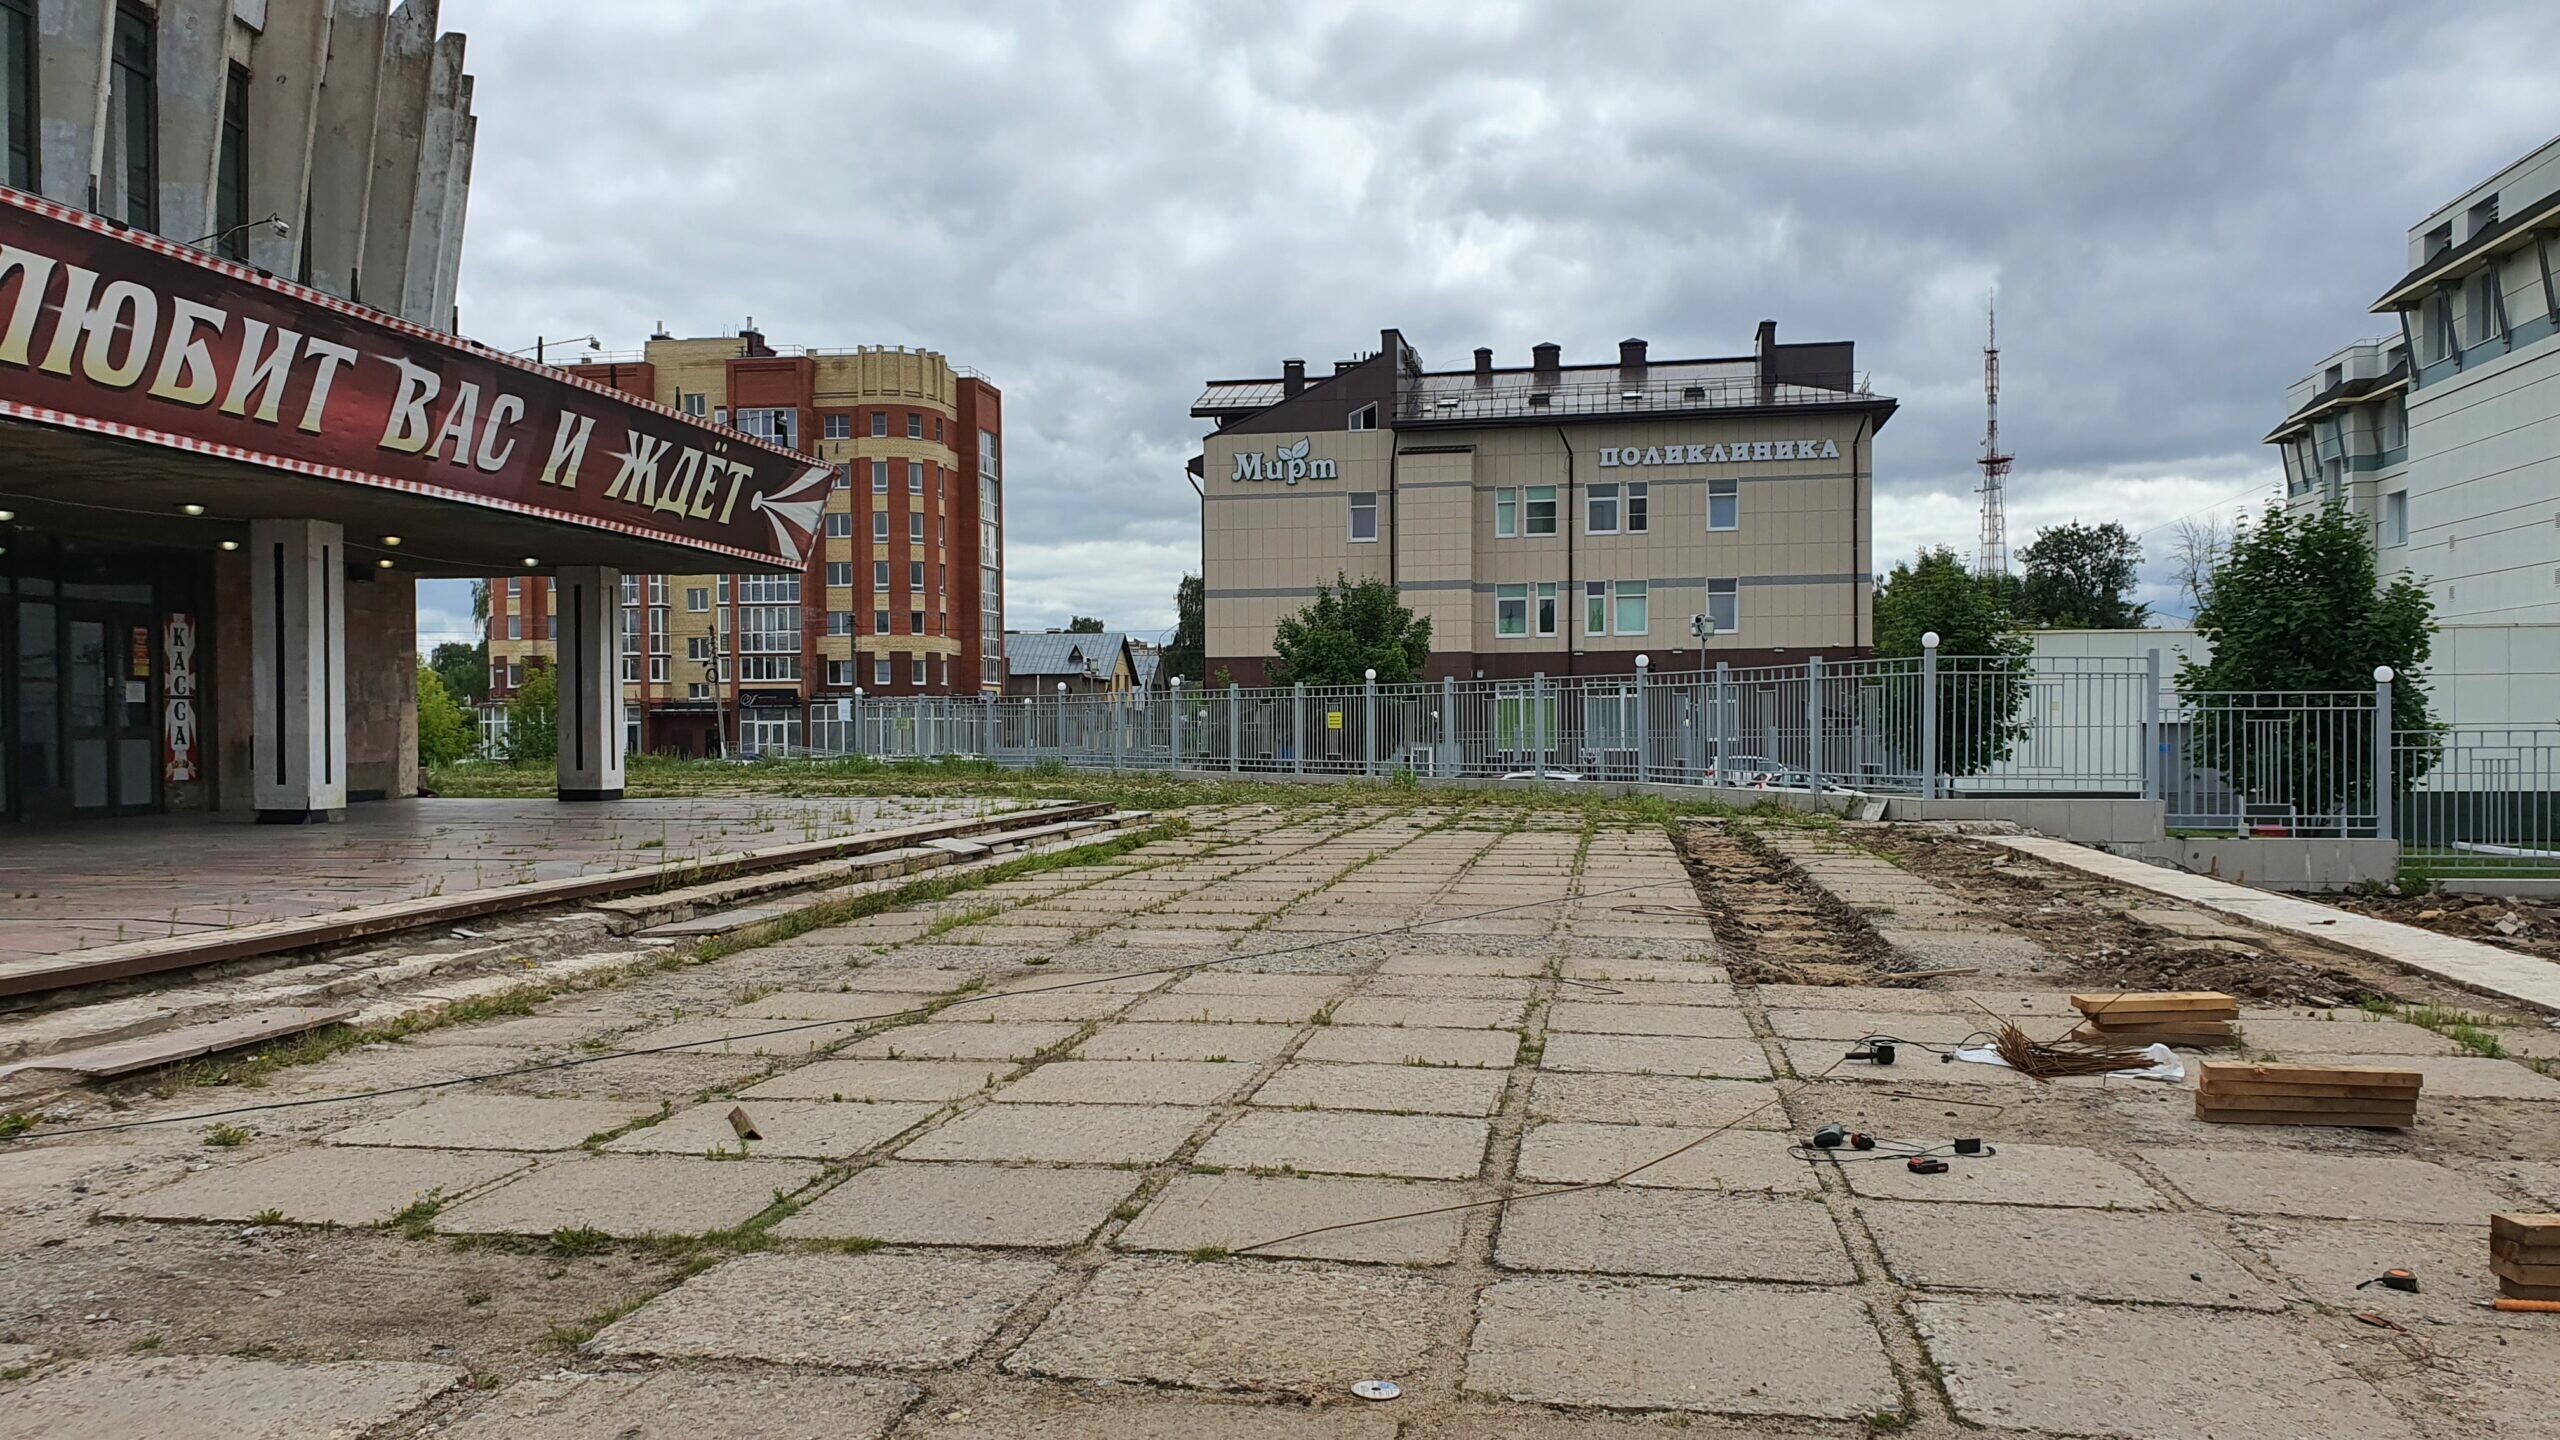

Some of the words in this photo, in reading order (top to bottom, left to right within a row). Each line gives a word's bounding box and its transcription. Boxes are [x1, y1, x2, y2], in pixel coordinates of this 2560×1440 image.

[376, 356, 525, 473] ВАС
[539, 409, 597, 489] И
[603, 428, 754, 525] ЖДЁТ
[1231, 452, 1338, 485] Мирт
[1599, 438, 1841, 468] ПОЛИКЛИНИКА
[172, 627, 187, 745] КАССА
